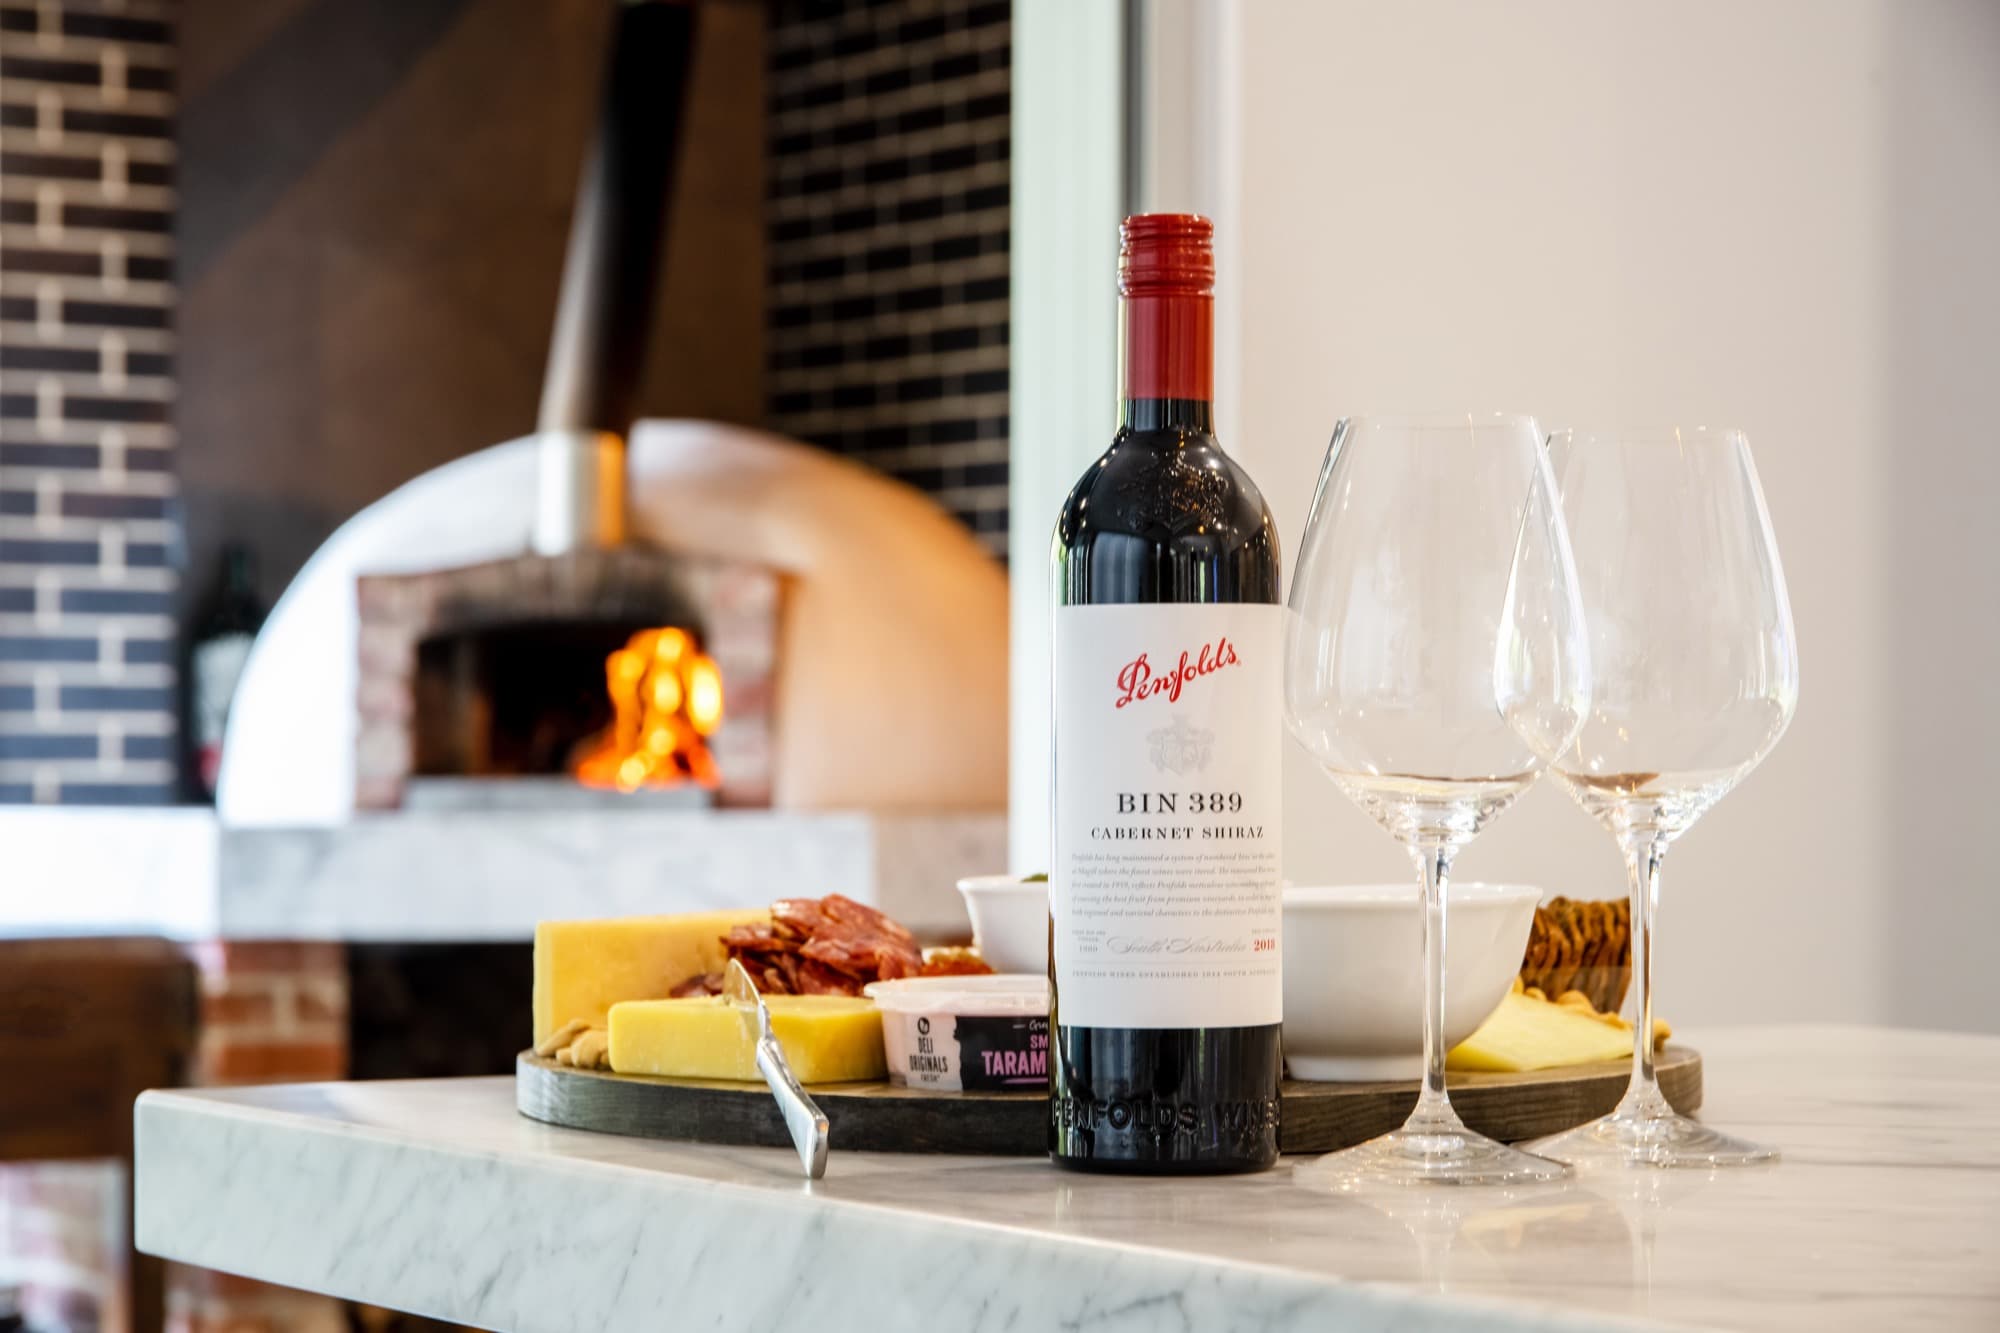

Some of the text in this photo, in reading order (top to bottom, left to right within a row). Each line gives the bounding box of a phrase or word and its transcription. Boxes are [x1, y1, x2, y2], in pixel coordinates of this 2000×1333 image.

[1115, 637, 1238, 708] Penfolds
[1117, 792, 1243, 814] BIN 389
[1091, 825, 1263, 840] CABERNET SHIRAZ
[918, 1037, 933, 1054] DELI
[909, 1055, 948, 1073] ORIGINALS
[981, 1051, 1047, 1075] TARAM
